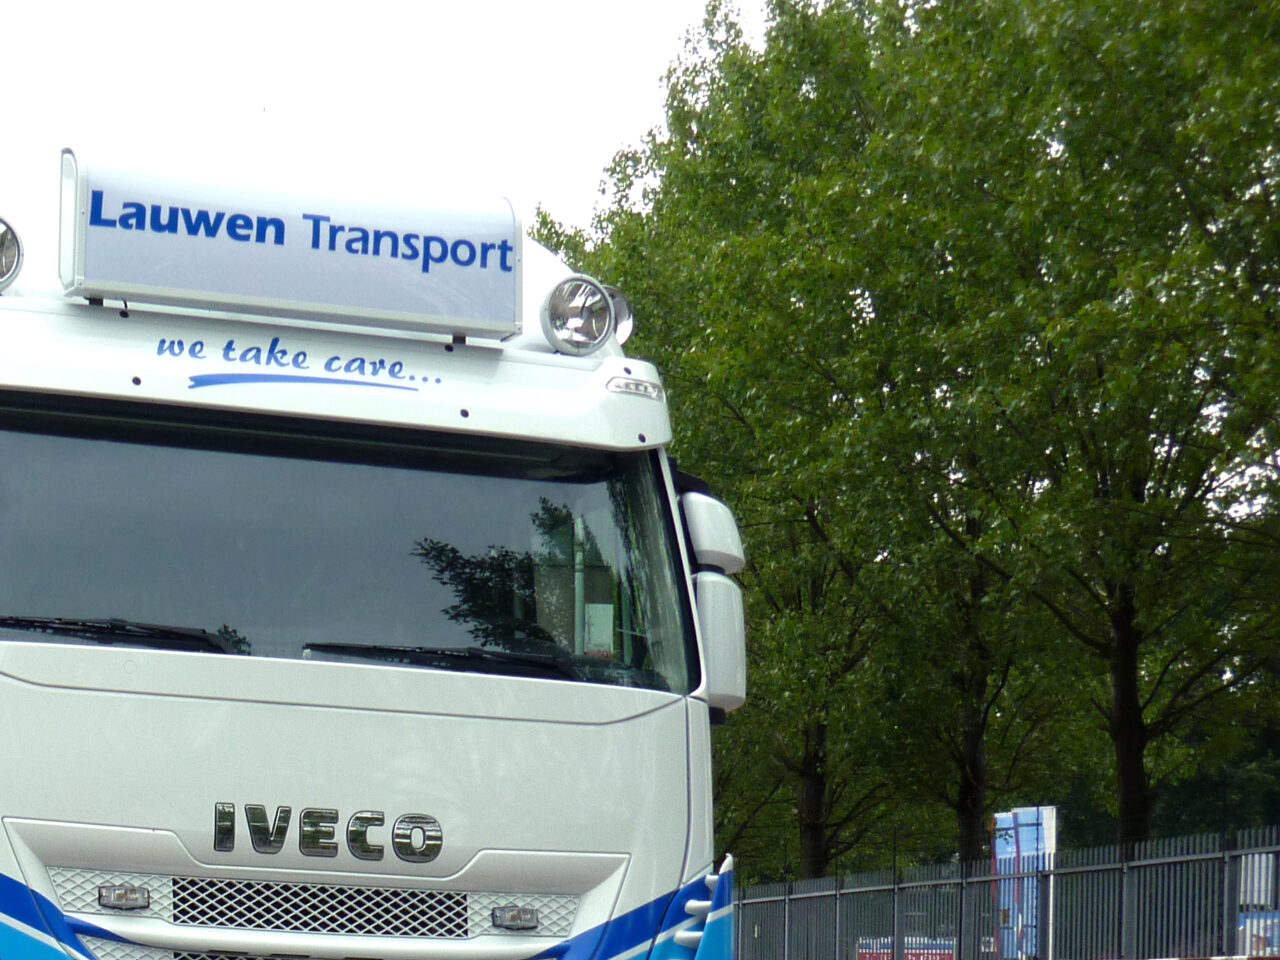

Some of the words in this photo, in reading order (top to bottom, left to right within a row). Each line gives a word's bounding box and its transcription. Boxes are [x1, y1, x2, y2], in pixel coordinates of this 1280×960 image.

[89, 190, 285, 246] Lauwen
[302, 213, 513, 273] Transport
[157, 334, 206, 361] we
[222, 336, 308, 371] take
[214, 803, 442, 862] IVECO
